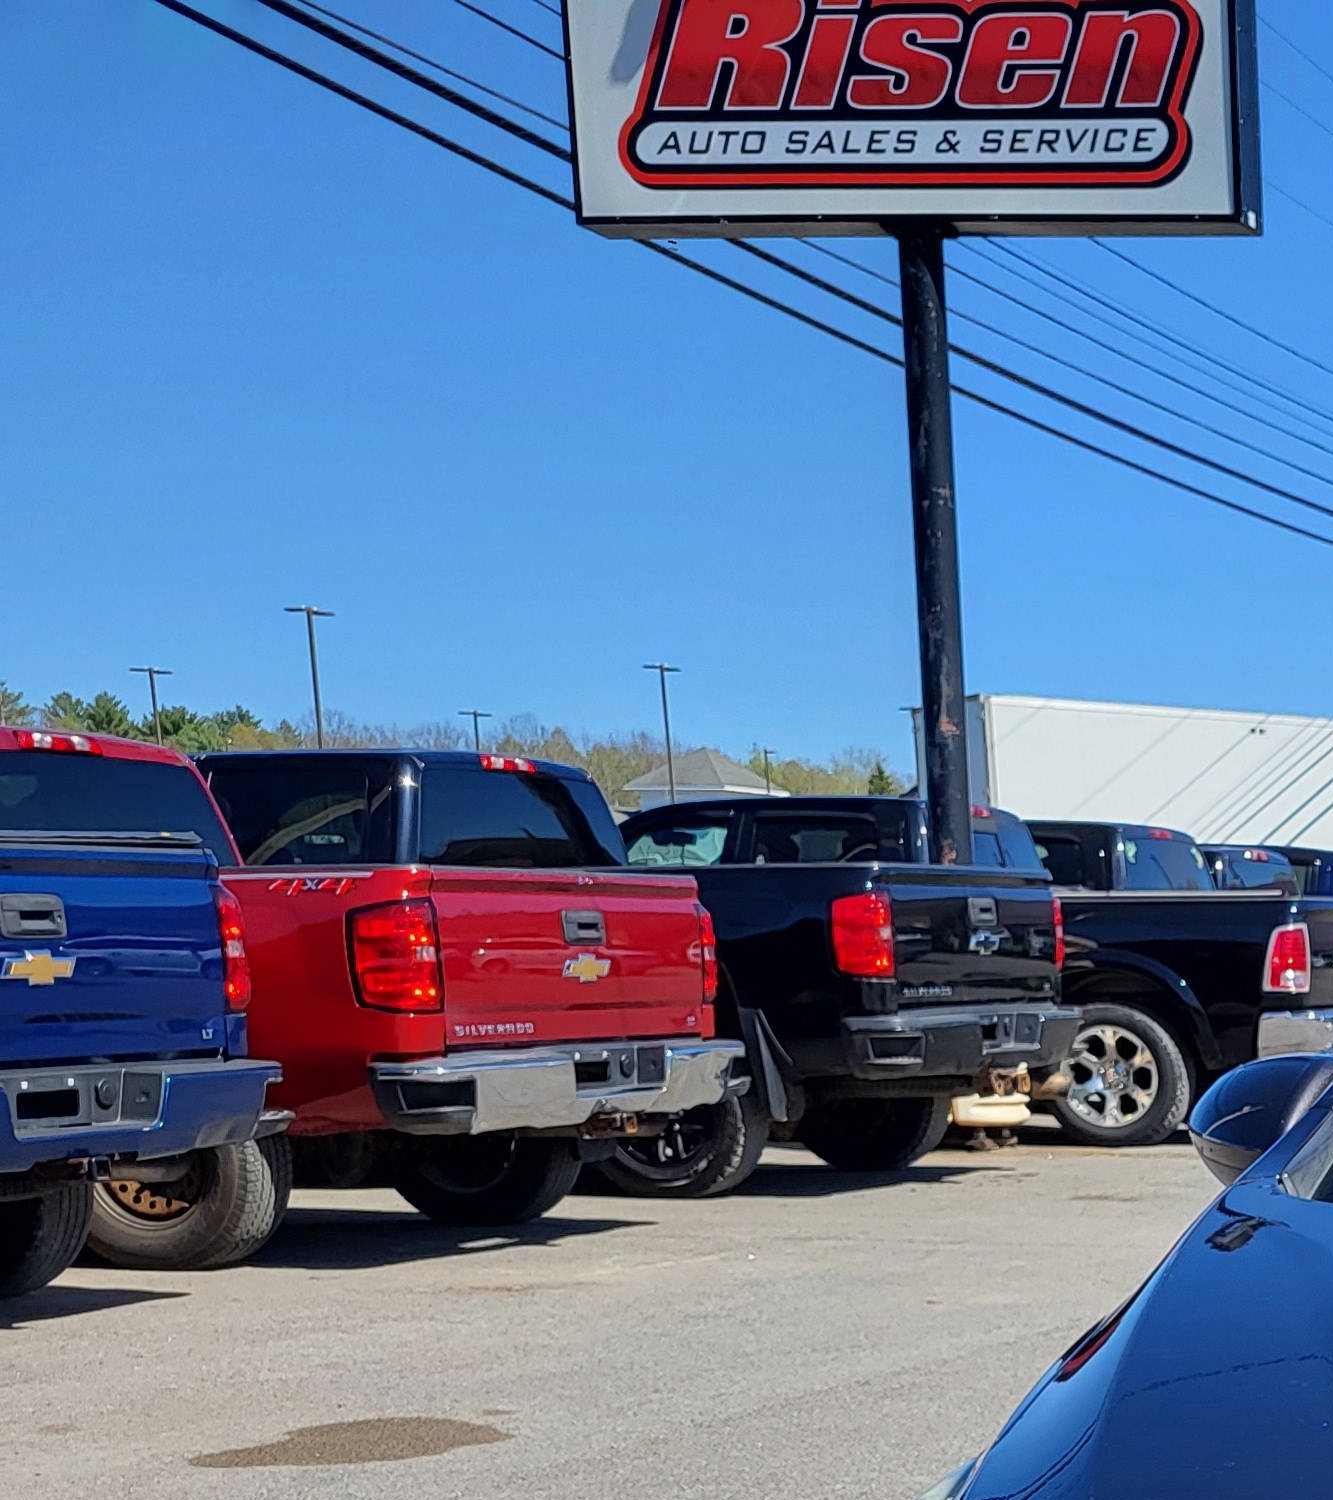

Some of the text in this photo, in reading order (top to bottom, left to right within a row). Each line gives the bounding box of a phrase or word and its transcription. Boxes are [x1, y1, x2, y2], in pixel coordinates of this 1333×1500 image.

[653, 0, 1181, 111] Risen
[657, 128, 1157, 155] AUTO SALES & SERVICE
